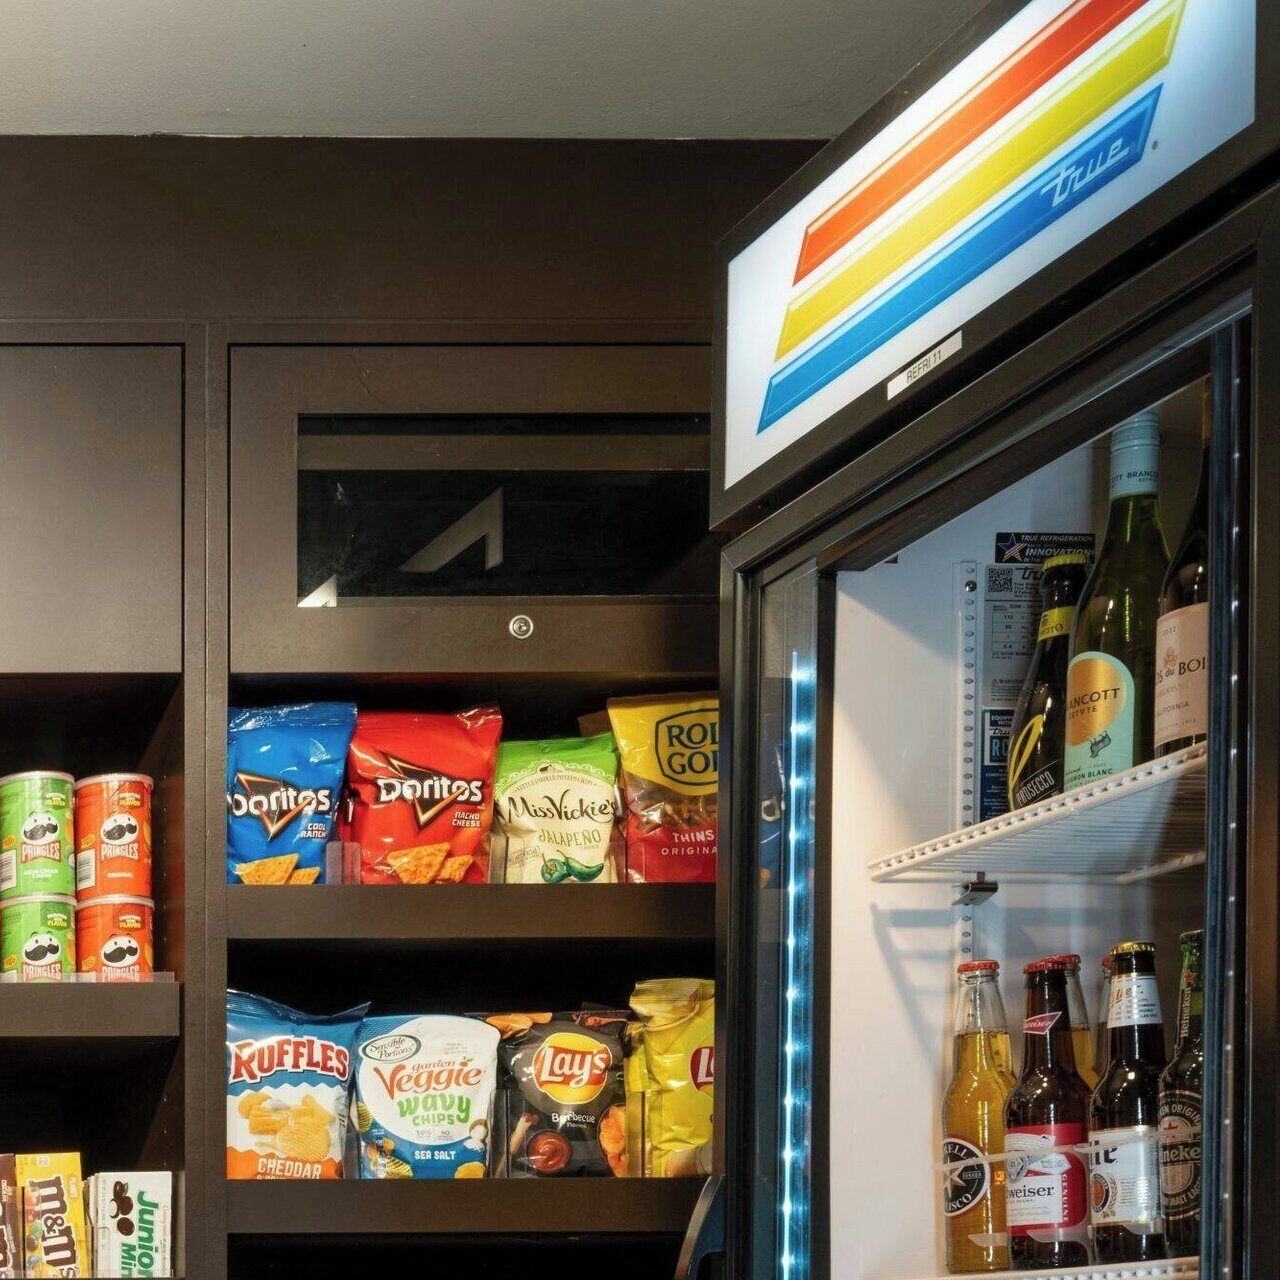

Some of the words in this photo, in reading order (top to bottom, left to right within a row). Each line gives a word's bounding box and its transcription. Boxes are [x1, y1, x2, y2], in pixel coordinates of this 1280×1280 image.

[1040, 138, 1131, 208] true
[376, 777, 483, 803] Doritos
[228, 787, 331, 817] Doritos
[452, 819, 481, 828] CHEESE
[455, 811, 480, 820] NACHO
[300, 830, 327, 838] RANCH
[308, 822, 326, 831] COOL
[672, 829, 715, 843] THINS
[21, 843, 60, 860] PRINGLES
[101, 843, 138, 860] PRINGLES
[23, 963, 61, 981] PRINGLES
[101, 964, 139, 982] PRINGLES
[369, 1036, 406, 1053] Sensible
[232, 1038, 349, 1082] RUFFLES
[411, 1060, 456, 1073] garden
[540, 1045, 608, 1088] Lay's
[373, 1063, 483, 1100] Veggie
[397, 1093, 472, 1124] wavy
[412, 1113, 455, 1127] CHIPS
[414, 1150, 432, 1160] SEA
[434, 1150, 456, 1160] SALT
[257, 1158, 322, 1179] CHEDDAR
